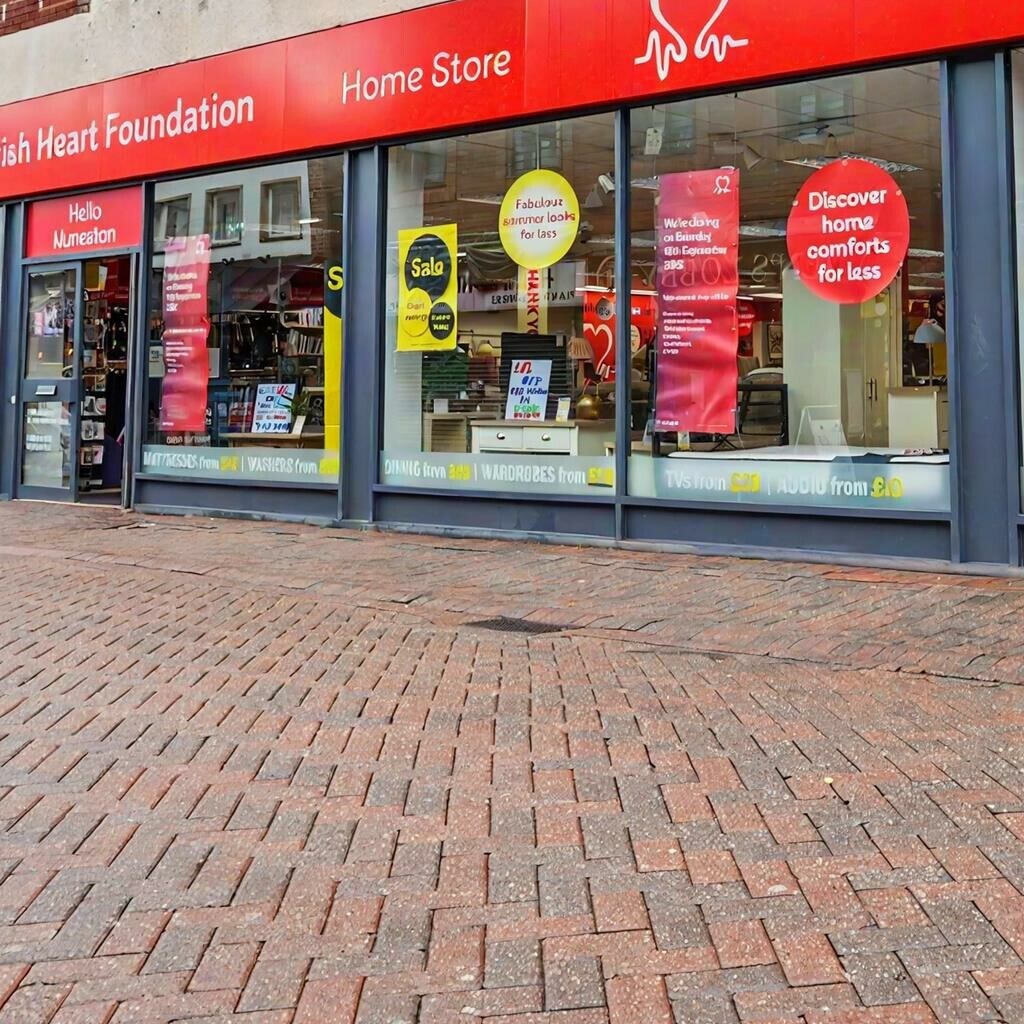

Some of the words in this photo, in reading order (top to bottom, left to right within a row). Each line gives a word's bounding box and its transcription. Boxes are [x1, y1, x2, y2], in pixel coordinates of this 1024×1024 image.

[342, 67, 424, 105] Home
[431, 50, 512, 88] Store
[37, 119, 99, 161] Heart
[105, 92, 254, 149] Foundation
[808, 189, 887, 211] Discover
[69, 200, 102, 224] Hello
[520, 229, 535, 239] for
[821, 215, 874, 233] home
[53, 226, 116, 249] Nuneaton
[807, 237, 891, 259] comforts
[411, 256, 444, 278] Sale
[818, 264, 844, 283] for
[847, 262, 881, 281] less
[295, 458, 318, 474] from
[481, 463, 556, 484] WARDROBES
[558, 466, 586, 484] from
[830, 476, 868, 496] from
